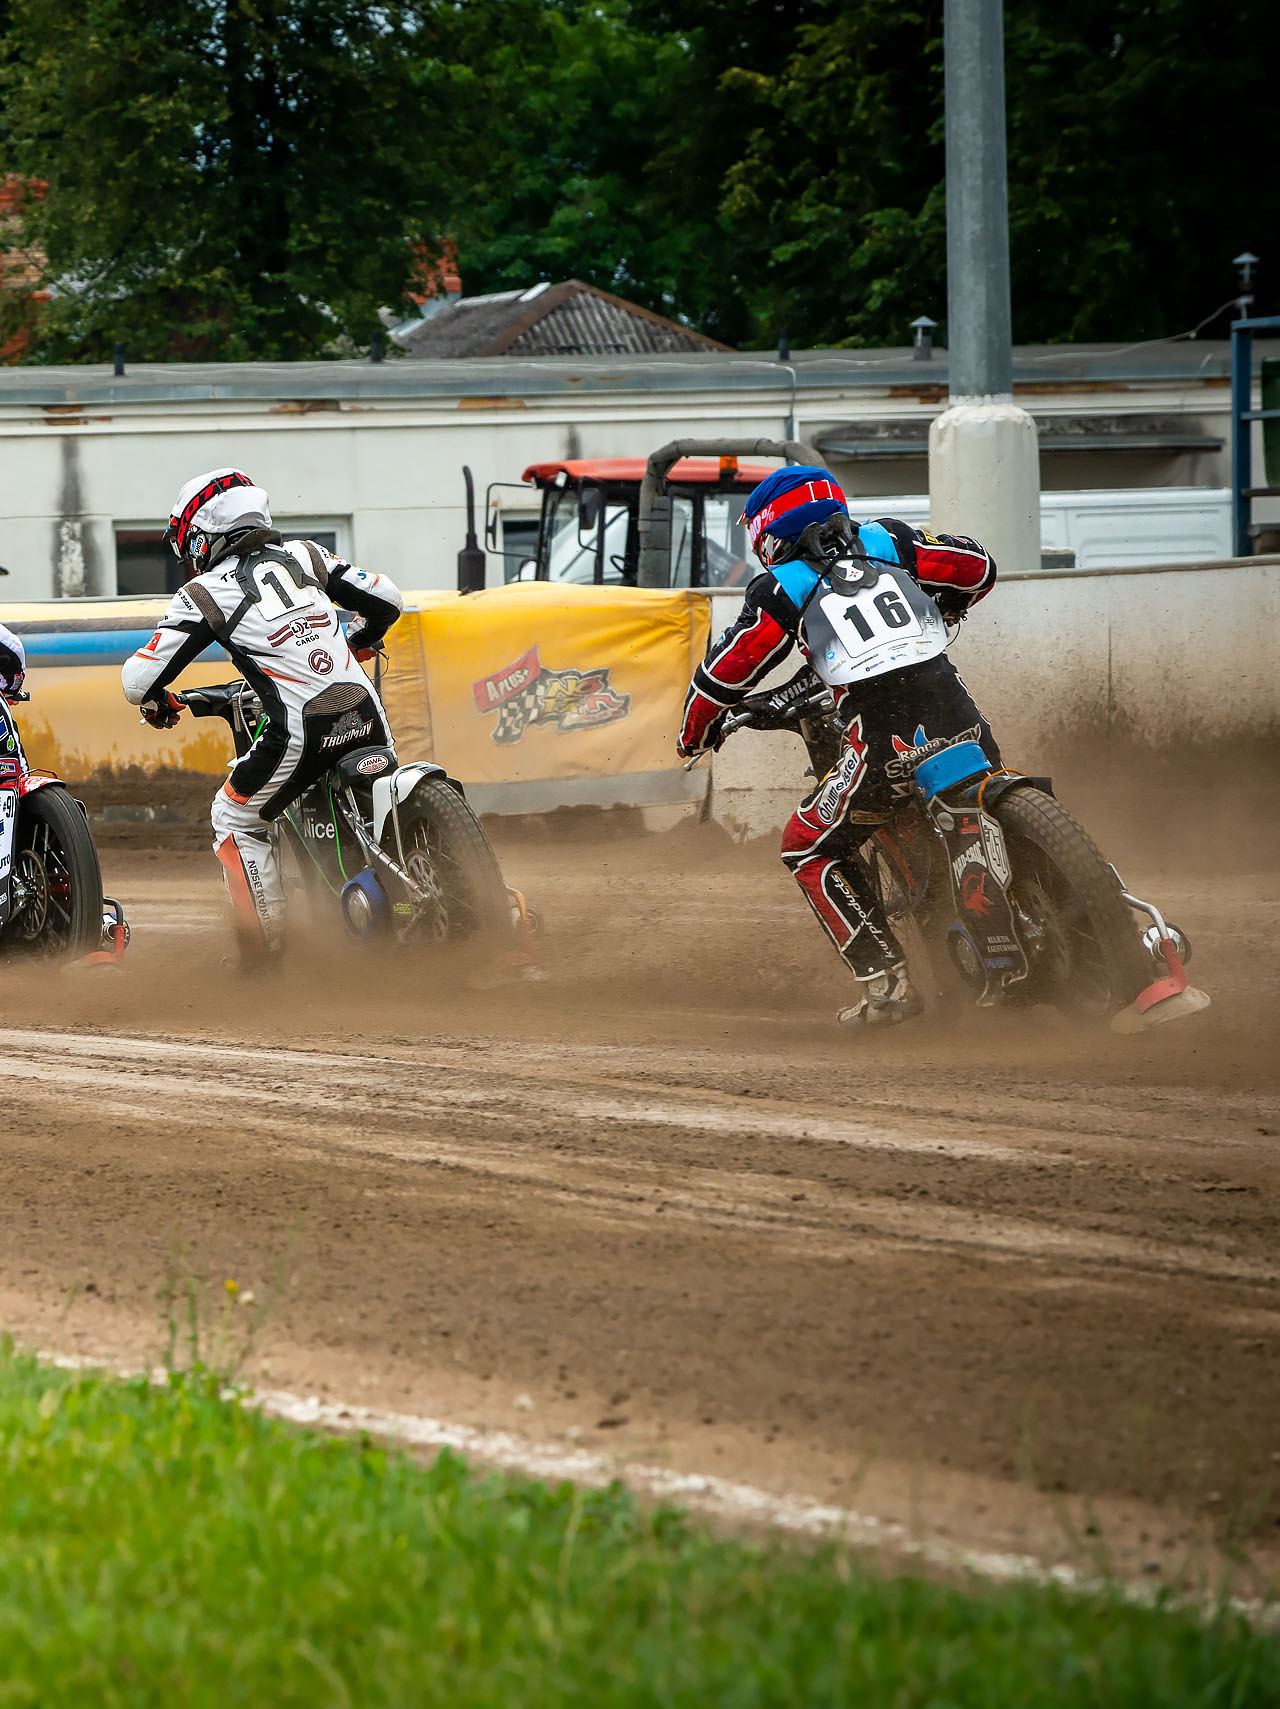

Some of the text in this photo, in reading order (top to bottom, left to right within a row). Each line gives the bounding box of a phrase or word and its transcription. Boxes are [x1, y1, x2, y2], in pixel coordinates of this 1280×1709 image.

[261, 570, 295, 609] 1
[843, 591, 911, 642] 16
[296, 634, 320, 647] CARGO
[362, 757, 383, 767] JAWA
[900, 739, 940, 762] Ranna
[304, 817, 335, 839] Nice
[830, 873, 896, 959] kw-products
